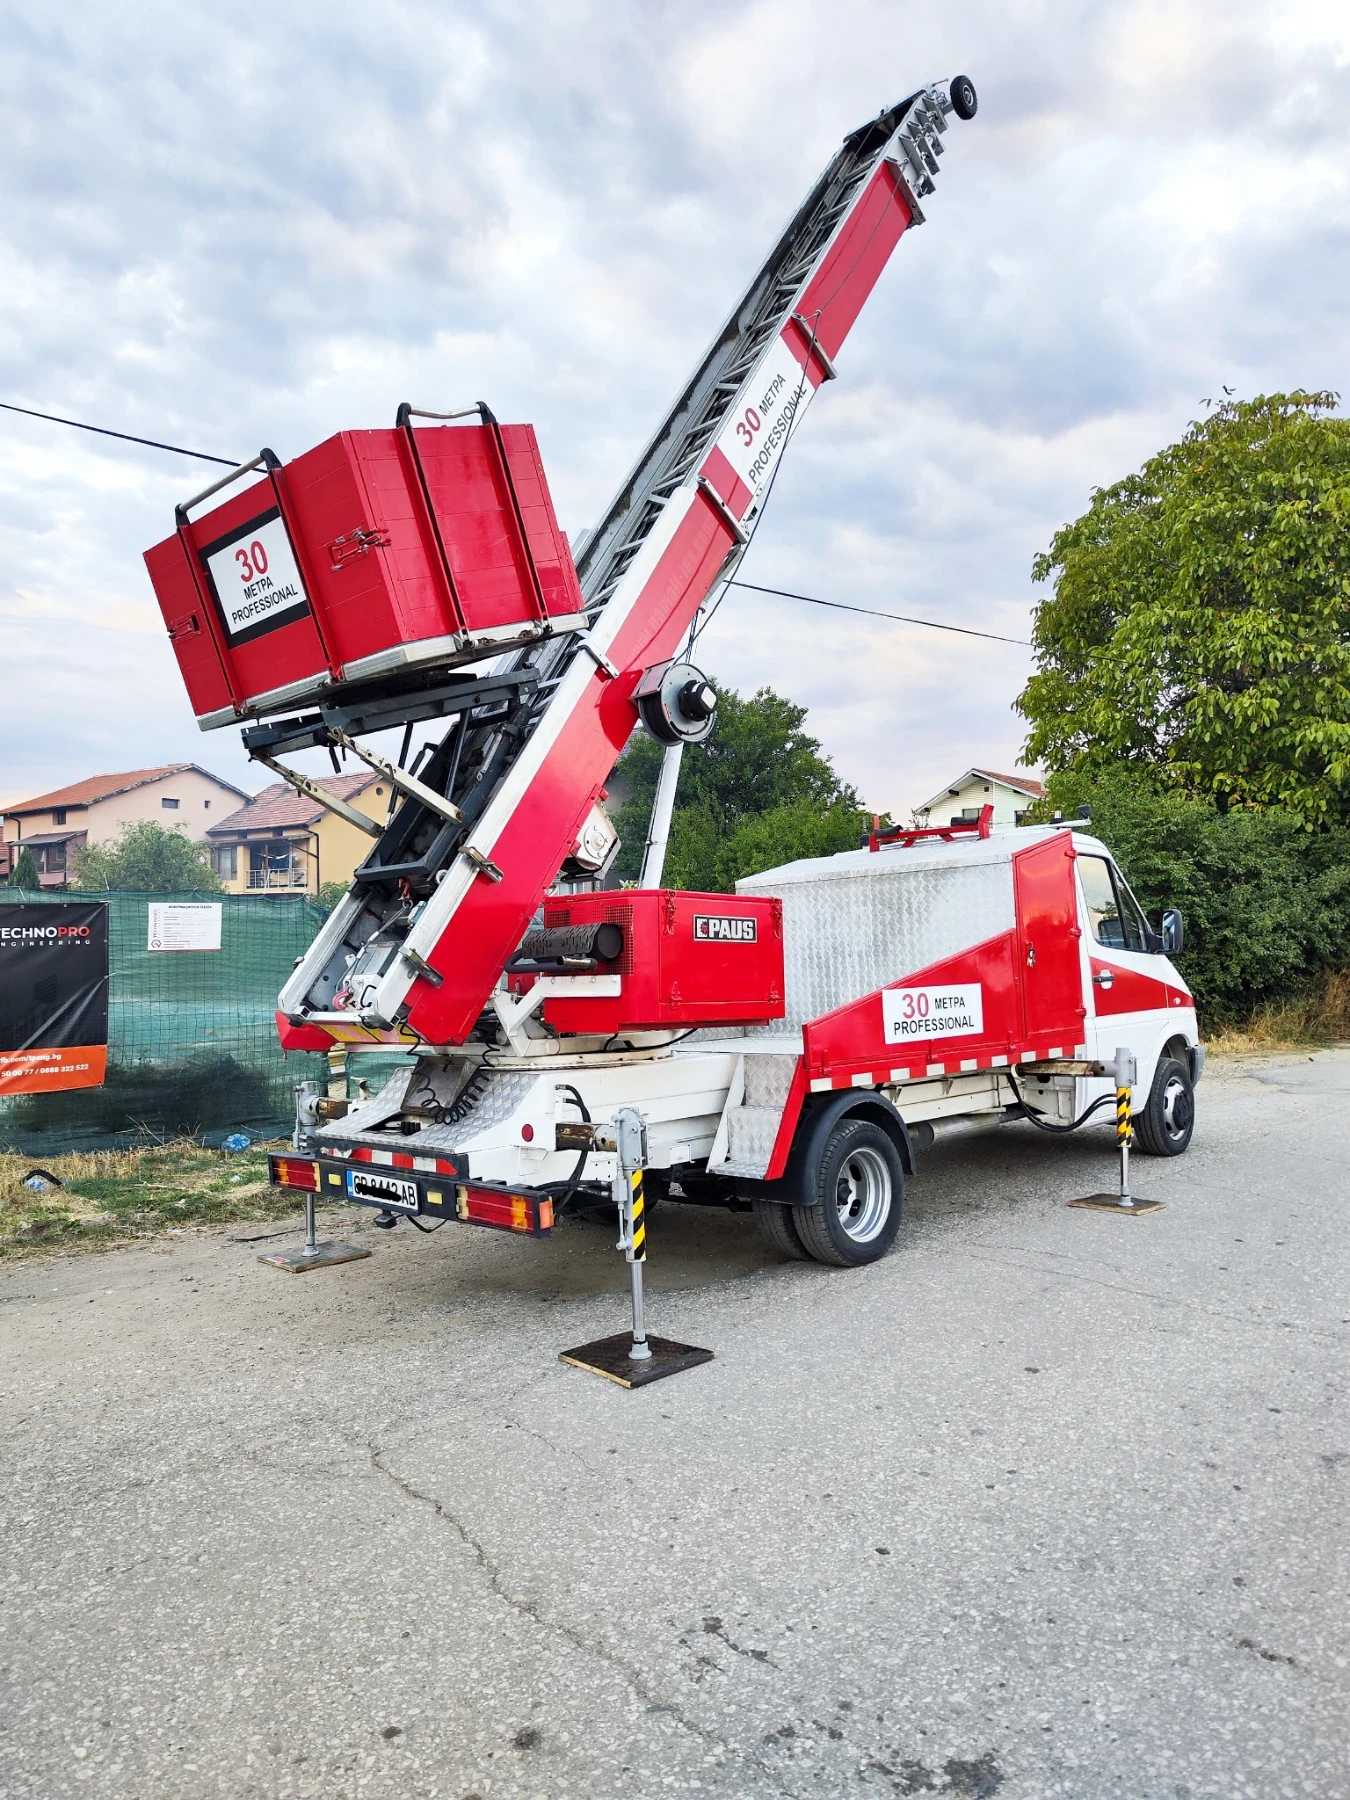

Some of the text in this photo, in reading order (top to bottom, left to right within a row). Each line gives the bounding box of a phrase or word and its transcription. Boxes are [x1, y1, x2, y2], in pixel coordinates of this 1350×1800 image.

[736, 373, 786, 447] 30 МЕТРА
[748, 384, 808, 485] PROFESSIONAL
[235, 540, 269, 583] 30
[243, 575, 274, 600] МЕТРА
[231, 583, 298, 625] PROFESSIONAL
[902, 992, 966, 1019] 30 МЕТРА
[893, 1015, 975, 1036] PROFESSIONAL
[75, 1063, 89, 1071] 522
[401, 1184, 416, 1206] AB
